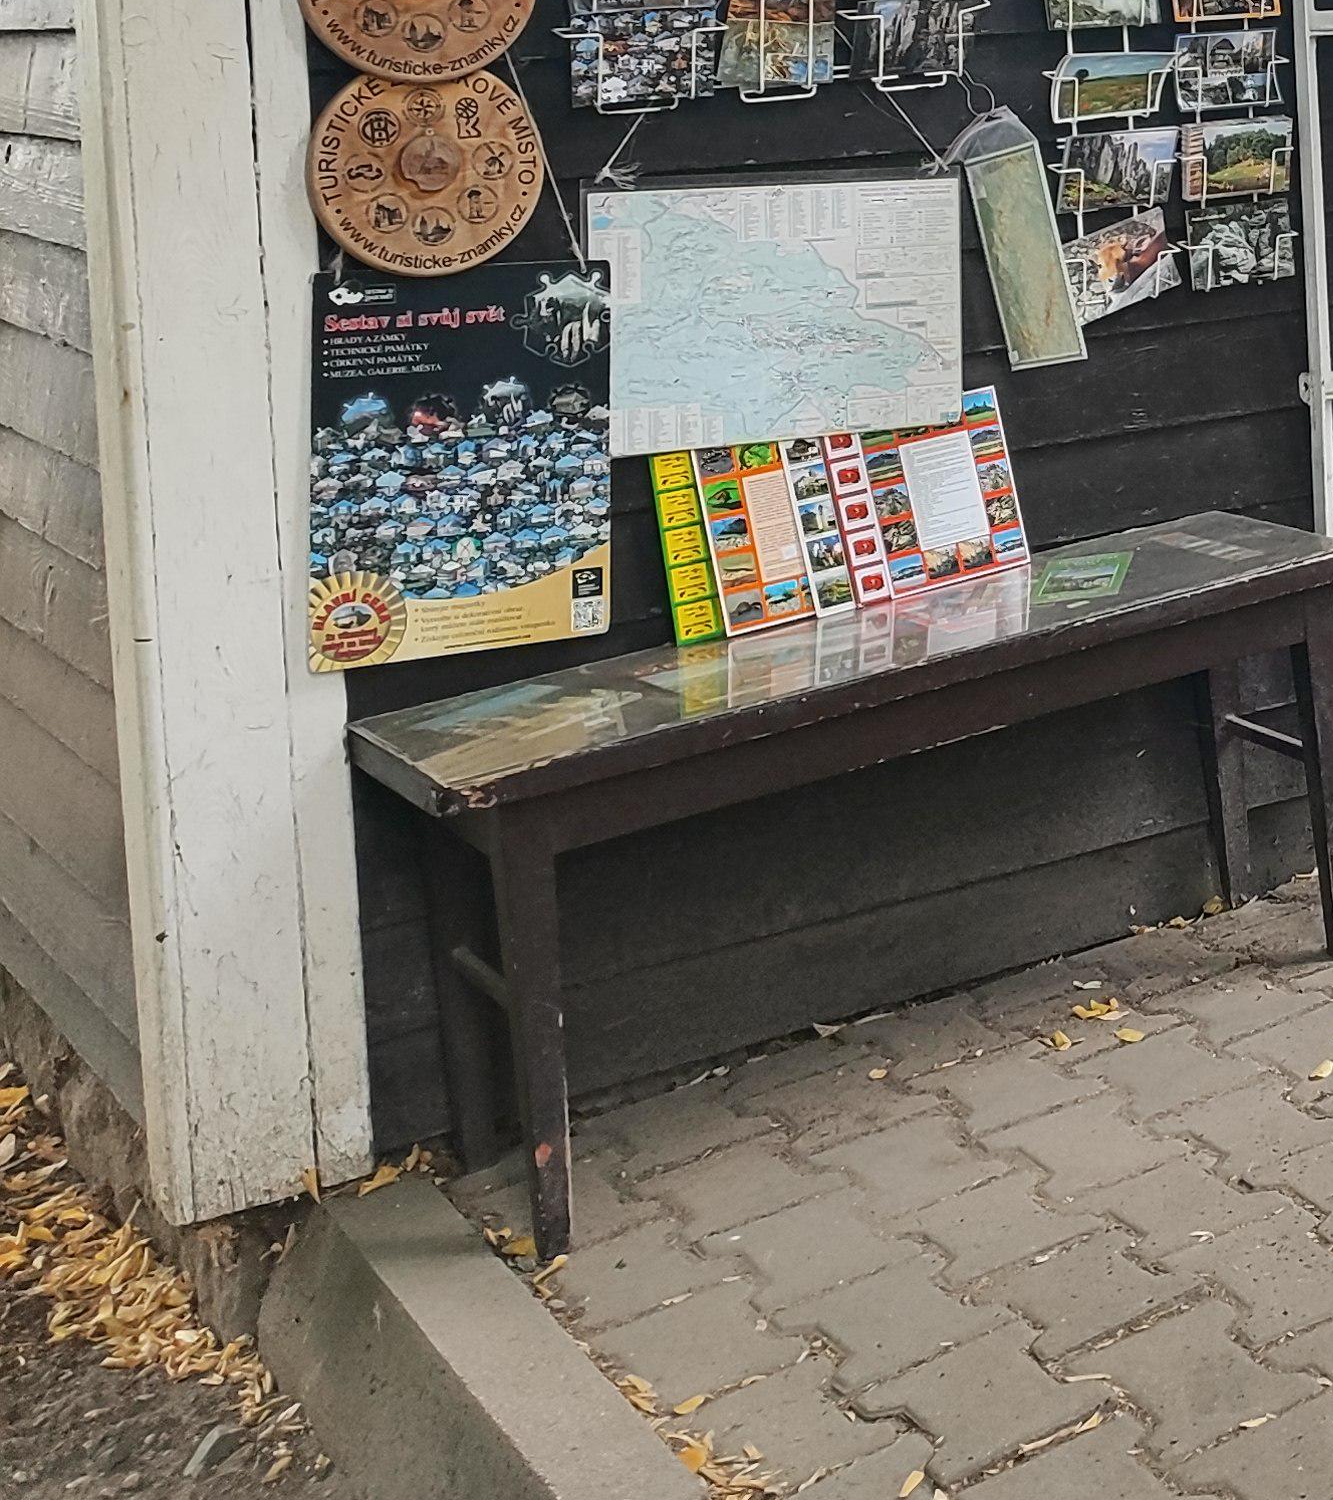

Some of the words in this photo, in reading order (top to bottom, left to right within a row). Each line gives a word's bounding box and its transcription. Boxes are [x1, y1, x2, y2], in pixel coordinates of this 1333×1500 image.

[326, 14, 521, 76] www.turisticke-znamky.cz
[508, 115, 537, 185] MÍSTO
[338, 203, 527, 269] www.turisticke-znamky.cz
[324, 313, 391, 332] Sestav
[395, 309, 413, 328] si
[418, 307, 460, 329] svůj
[465, 304, 506, 325] svět
[330, 336, 362, 346] HRADY
[330, 345, 382, 357] TECHNICKÉ
[384, 342, 430, 353] PAMÁTKY
[329, 356, 376, 368] CÍRKEVNÍ
[376, 353, 422, 365] PAMÁTKY
[411, 363, 442, 374] MĚSTA
